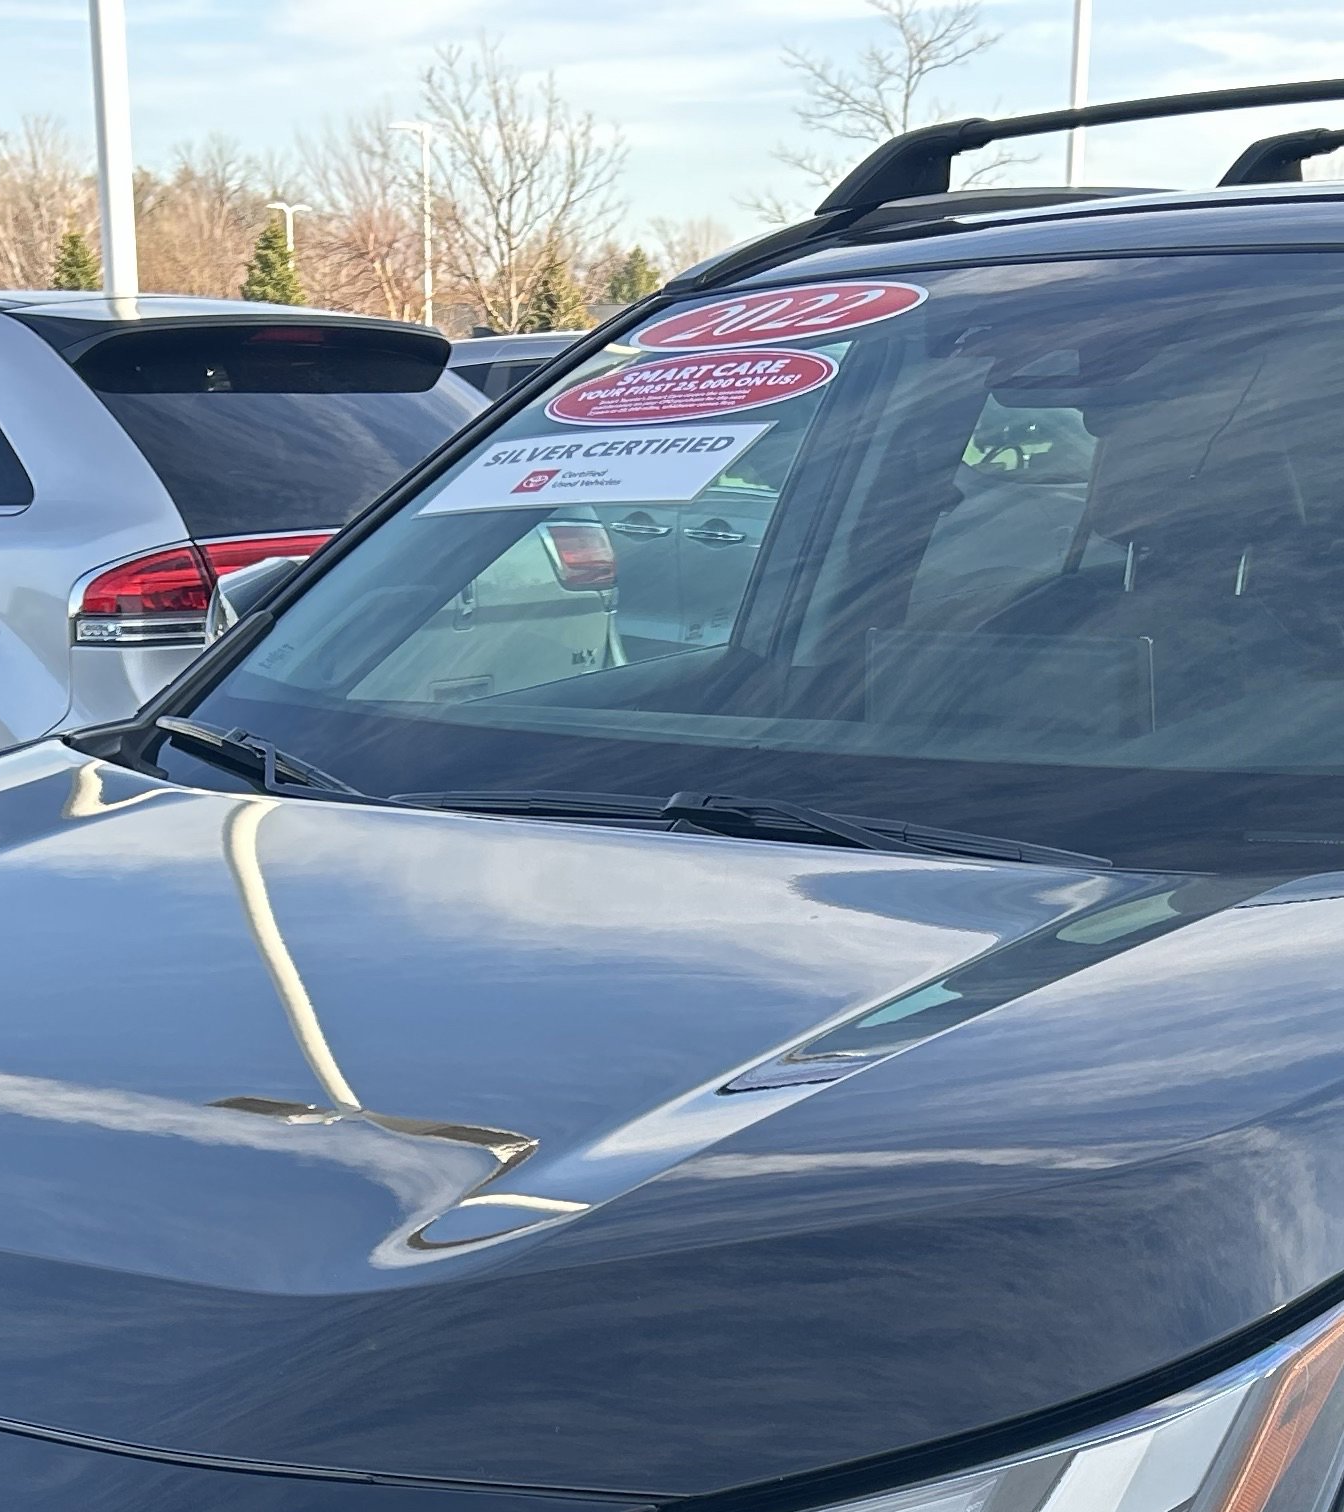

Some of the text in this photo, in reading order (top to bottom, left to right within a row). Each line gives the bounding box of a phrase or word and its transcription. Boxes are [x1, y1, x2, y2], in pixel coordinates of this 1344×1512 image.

[660, 289, 885, 343] 2022
[578, 386, 626, 401] YOUR
[625, 380, 678, 396] FIRST
[733, 374, 771, 387] ON
[766, 373, 801, 385] US!
[616, 359, 792, 386] SMART CARE
[483, 436, 736, 467] SILVER CERTIFIED
